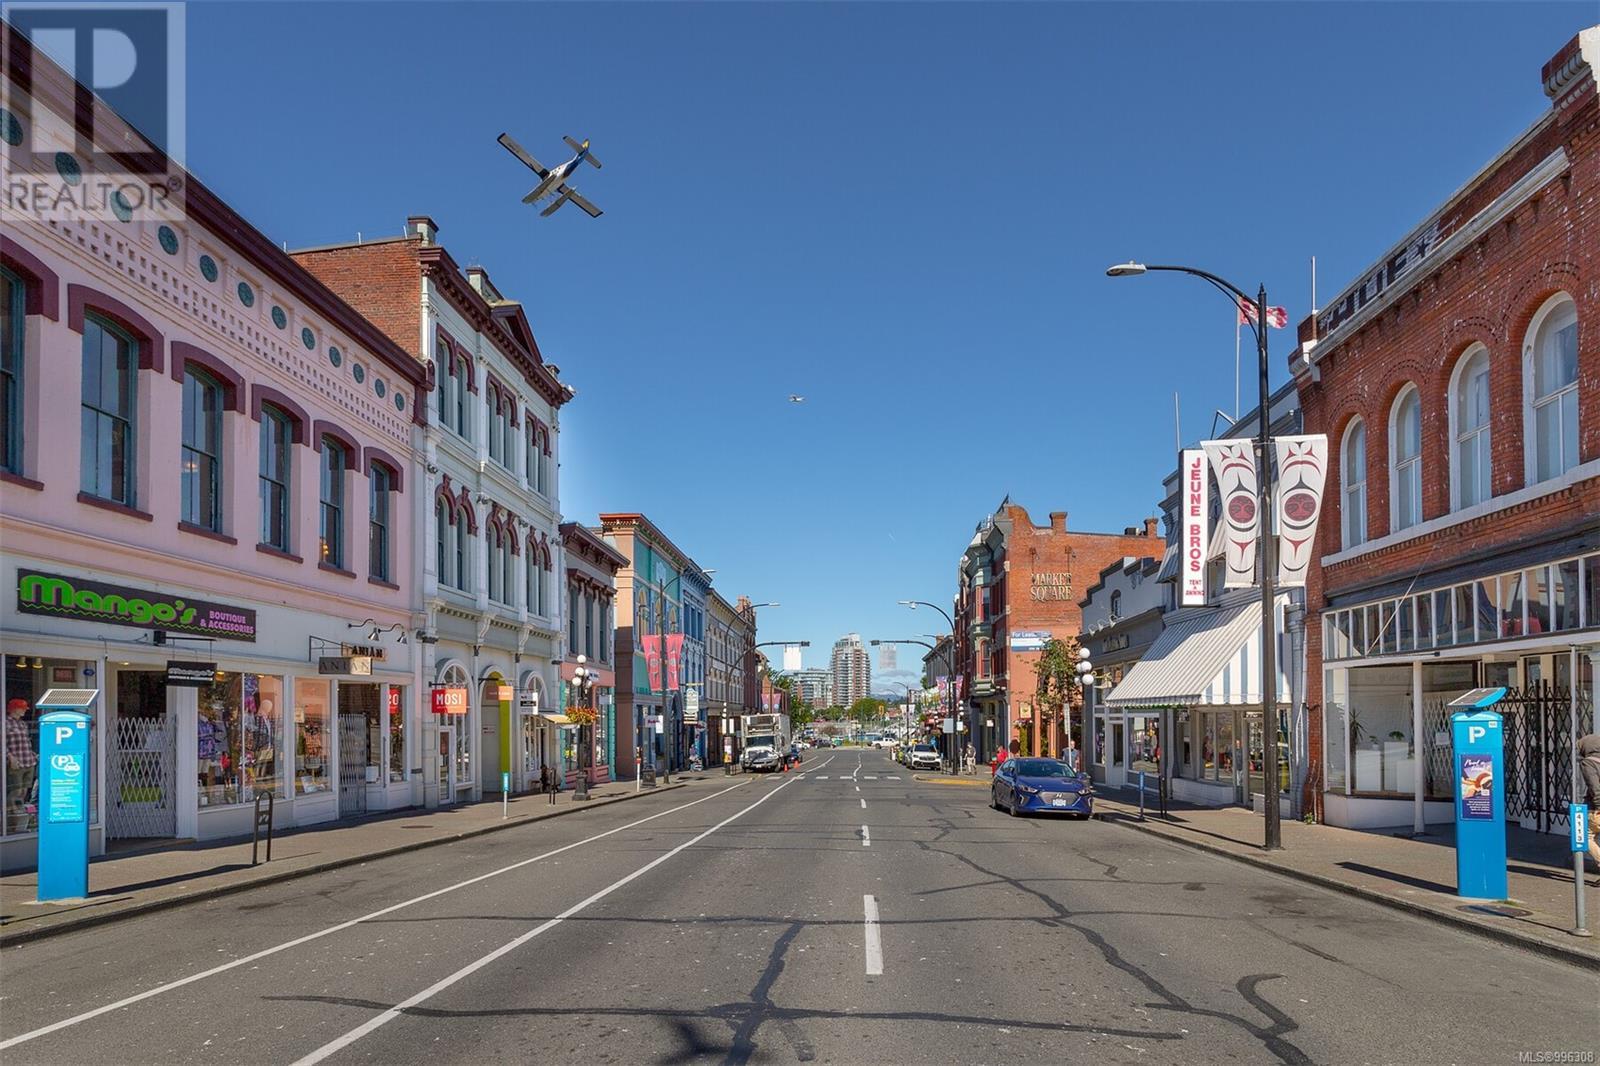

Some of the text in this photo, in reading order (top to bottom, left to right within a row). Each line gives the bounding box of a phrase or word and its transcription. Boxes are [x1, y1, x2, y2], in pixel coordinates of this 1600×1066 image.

[1189, 457, 1201, 572] JEUNE BROS
[1031, 573, 1072, 585] MARKET
[20, 575, 197, 623] Mango's
[1031, 586, 1072, 602] SQUARE
[209, 610, 246, 624] BOUTIQUE
[200, 618, 254, 634] & ACCESSORIES
[351, 645, 383, 658] ANIAN
[436, 693, 462, 705] MOSI
[56, 727, 73, 744] P
[1469, 726, 1486, 743] P
